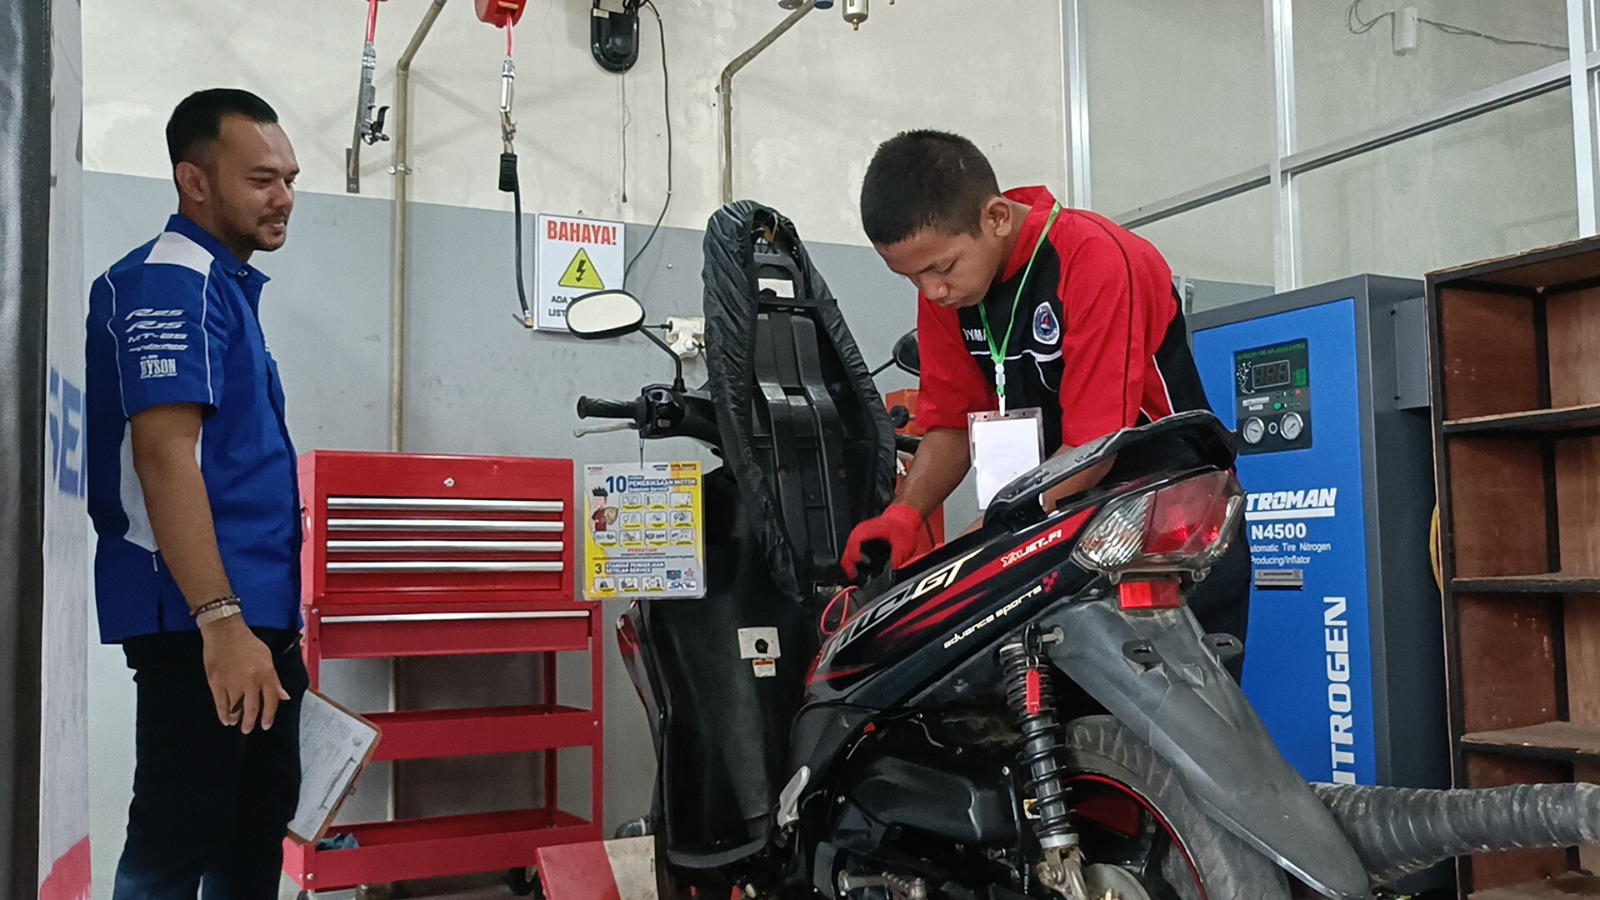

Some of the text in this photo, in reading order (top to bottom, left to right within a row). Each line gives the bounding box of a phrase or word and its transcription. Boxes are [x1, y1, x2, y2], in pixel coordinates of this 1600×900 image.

[547, 220, 617, 246] BAHAYA!
[551, 295, 568, 304] ADA
[548, 308, 567, 317] LIST
[605, 475, 627, 494] 10
[1245, 487, 1338, 512] TROMAN
[1251, 522, 1307, 540] N4500
[1250, 541, 1332, 554] utomatic Tire Nitrogen
[594, 563, 602, 575] 3
[943, 584, 1043, 649] advance sports
[1323, 596, 1356, 785] ITROGEN
